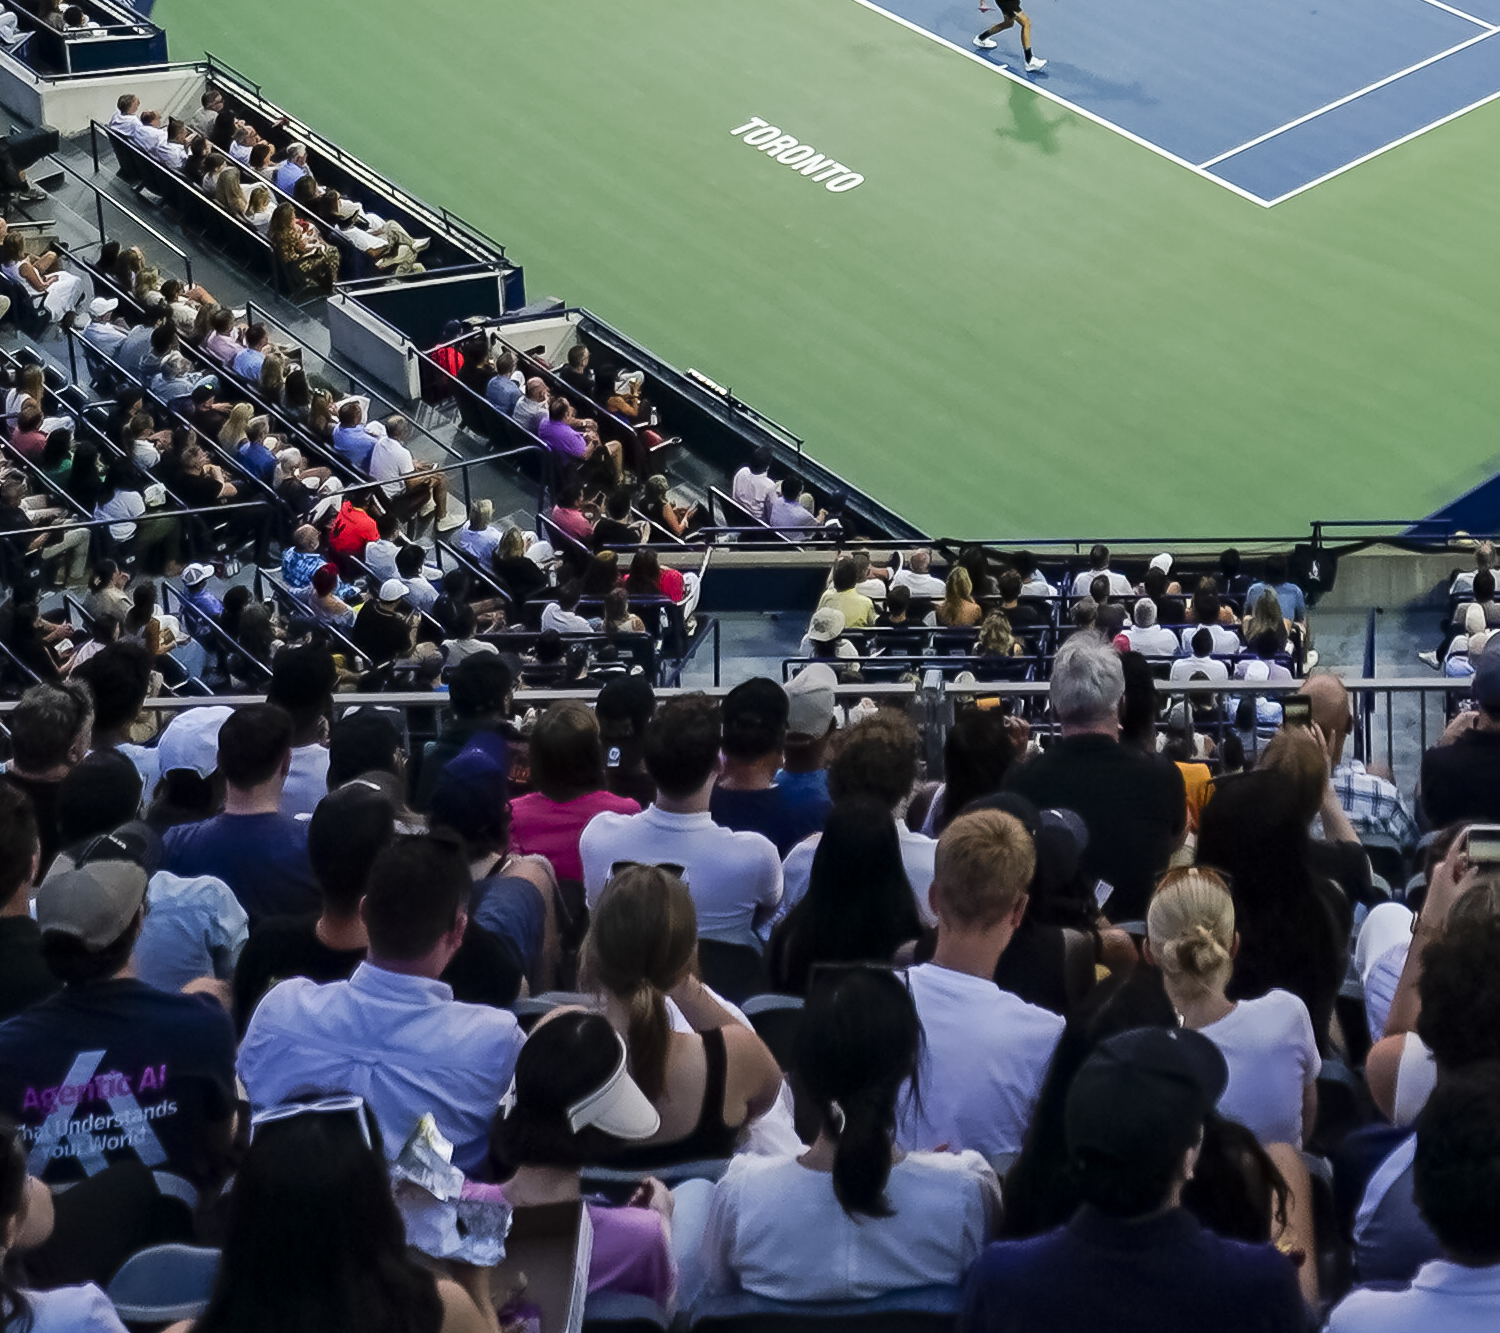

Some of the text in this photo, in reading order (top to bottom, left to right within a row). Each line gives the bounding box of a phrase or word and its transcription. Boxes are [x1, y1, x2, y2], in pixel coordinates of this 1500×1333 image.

[729, 116, 866, 194] TORONTO
[23, 1063, 168, 1116] Agentic AI
[55, 1098, 179, 1138] Understands
